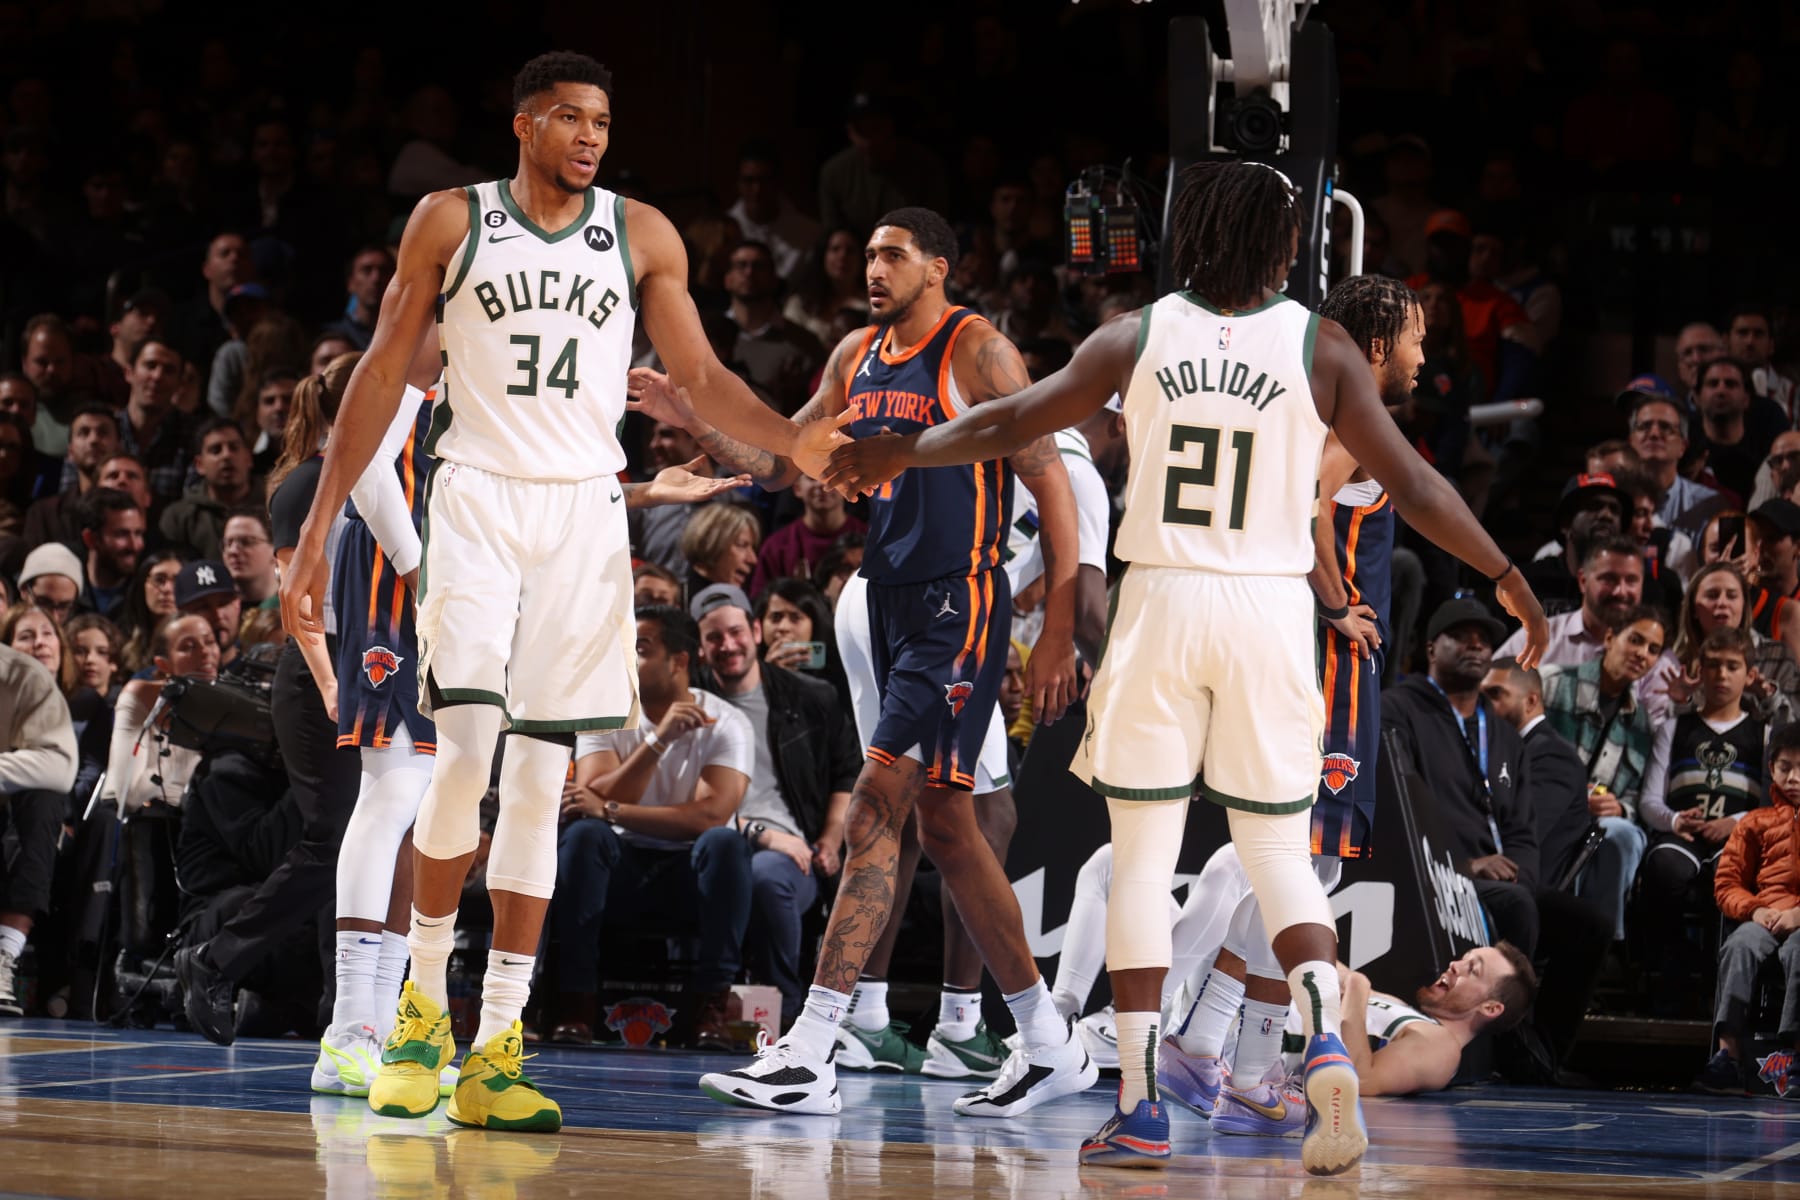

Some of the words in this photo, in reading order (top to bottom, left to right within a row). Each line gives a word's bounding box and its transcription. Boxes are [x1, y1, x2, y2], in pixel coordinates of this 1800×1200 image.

[474, 270, 620, 329] BUCKS
[506, 334, 580, 399] 34
[1155, 358, 1287, 412] HOLIDAY
[885, 390, 935, 426] YORK
[1162, 424, 1254, 530] 21
[1322, 757, 1357, 776] NICKS
